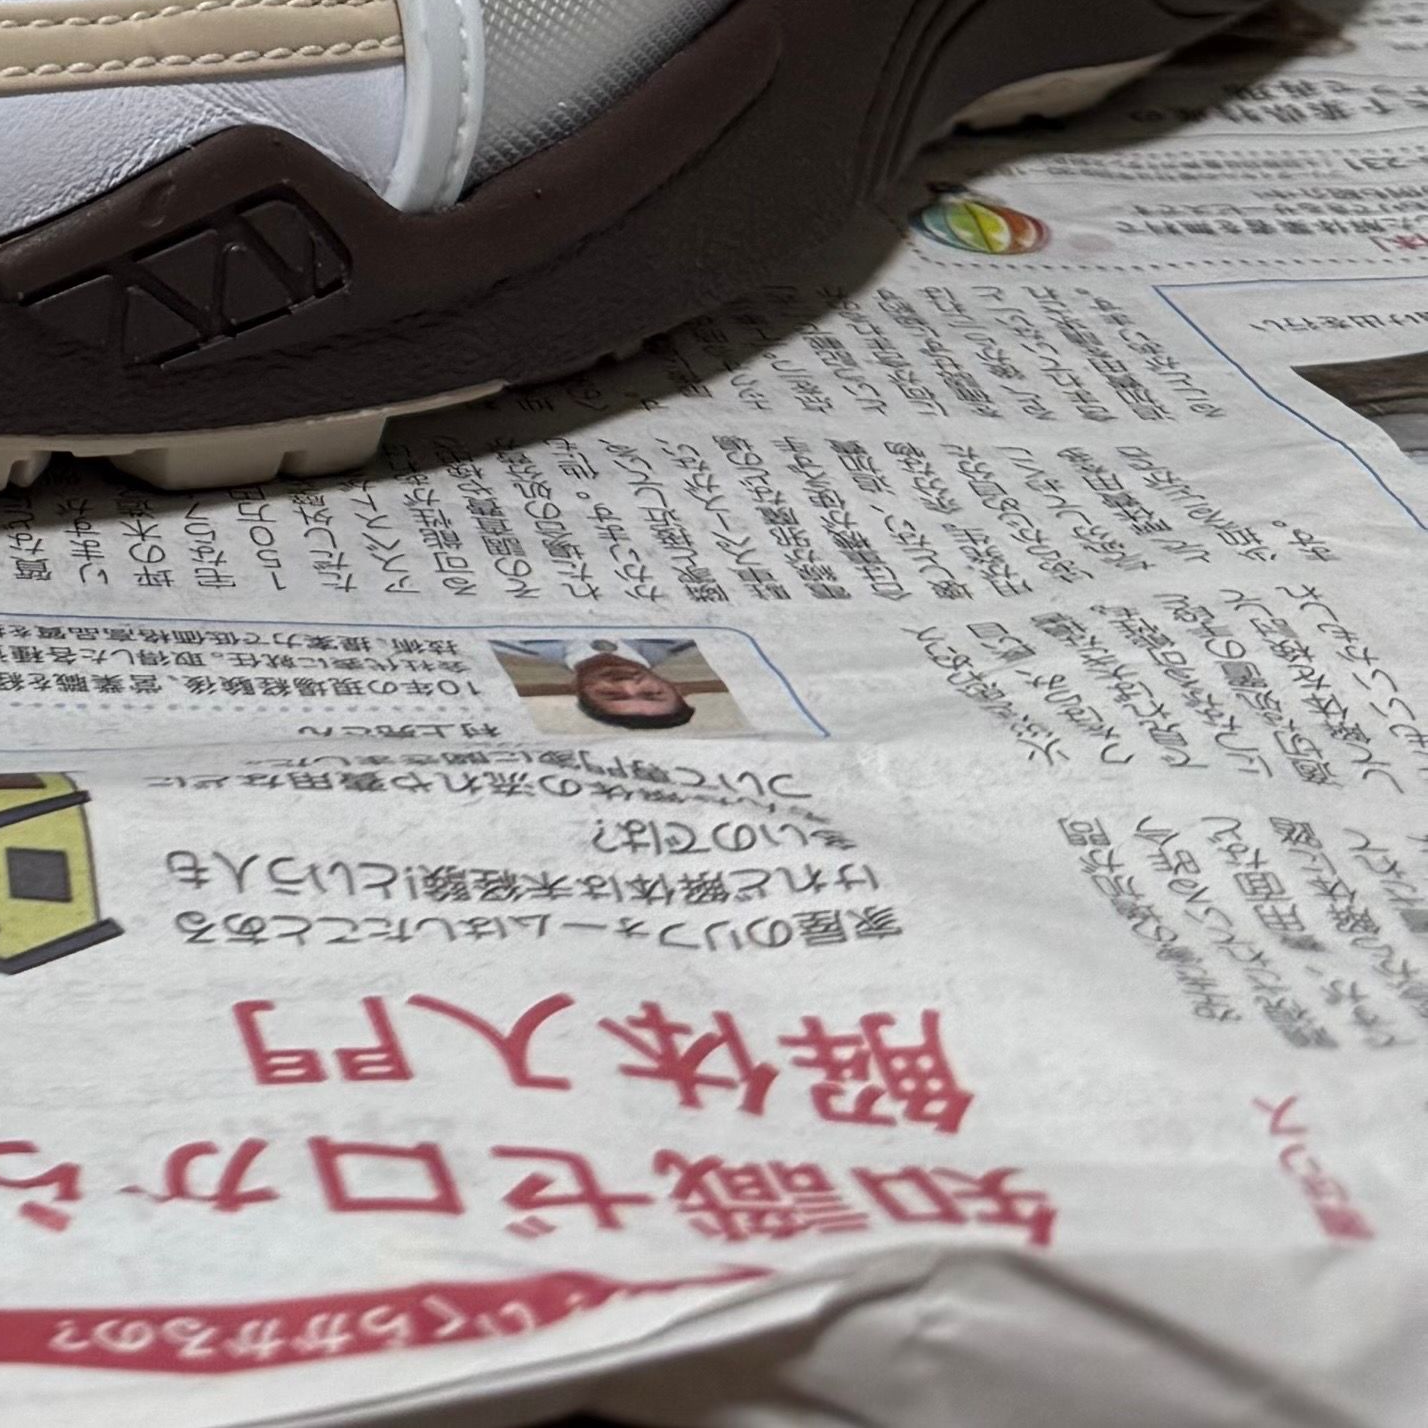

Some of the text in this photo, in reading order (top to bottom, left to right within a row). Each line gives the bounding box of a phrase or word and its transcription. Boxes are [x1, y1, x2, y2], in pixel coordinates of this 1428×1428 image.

[176, 907, 903, 949] 家屋のリフォームはしたことある
[236, 993, 971, 1135] 解体入門
